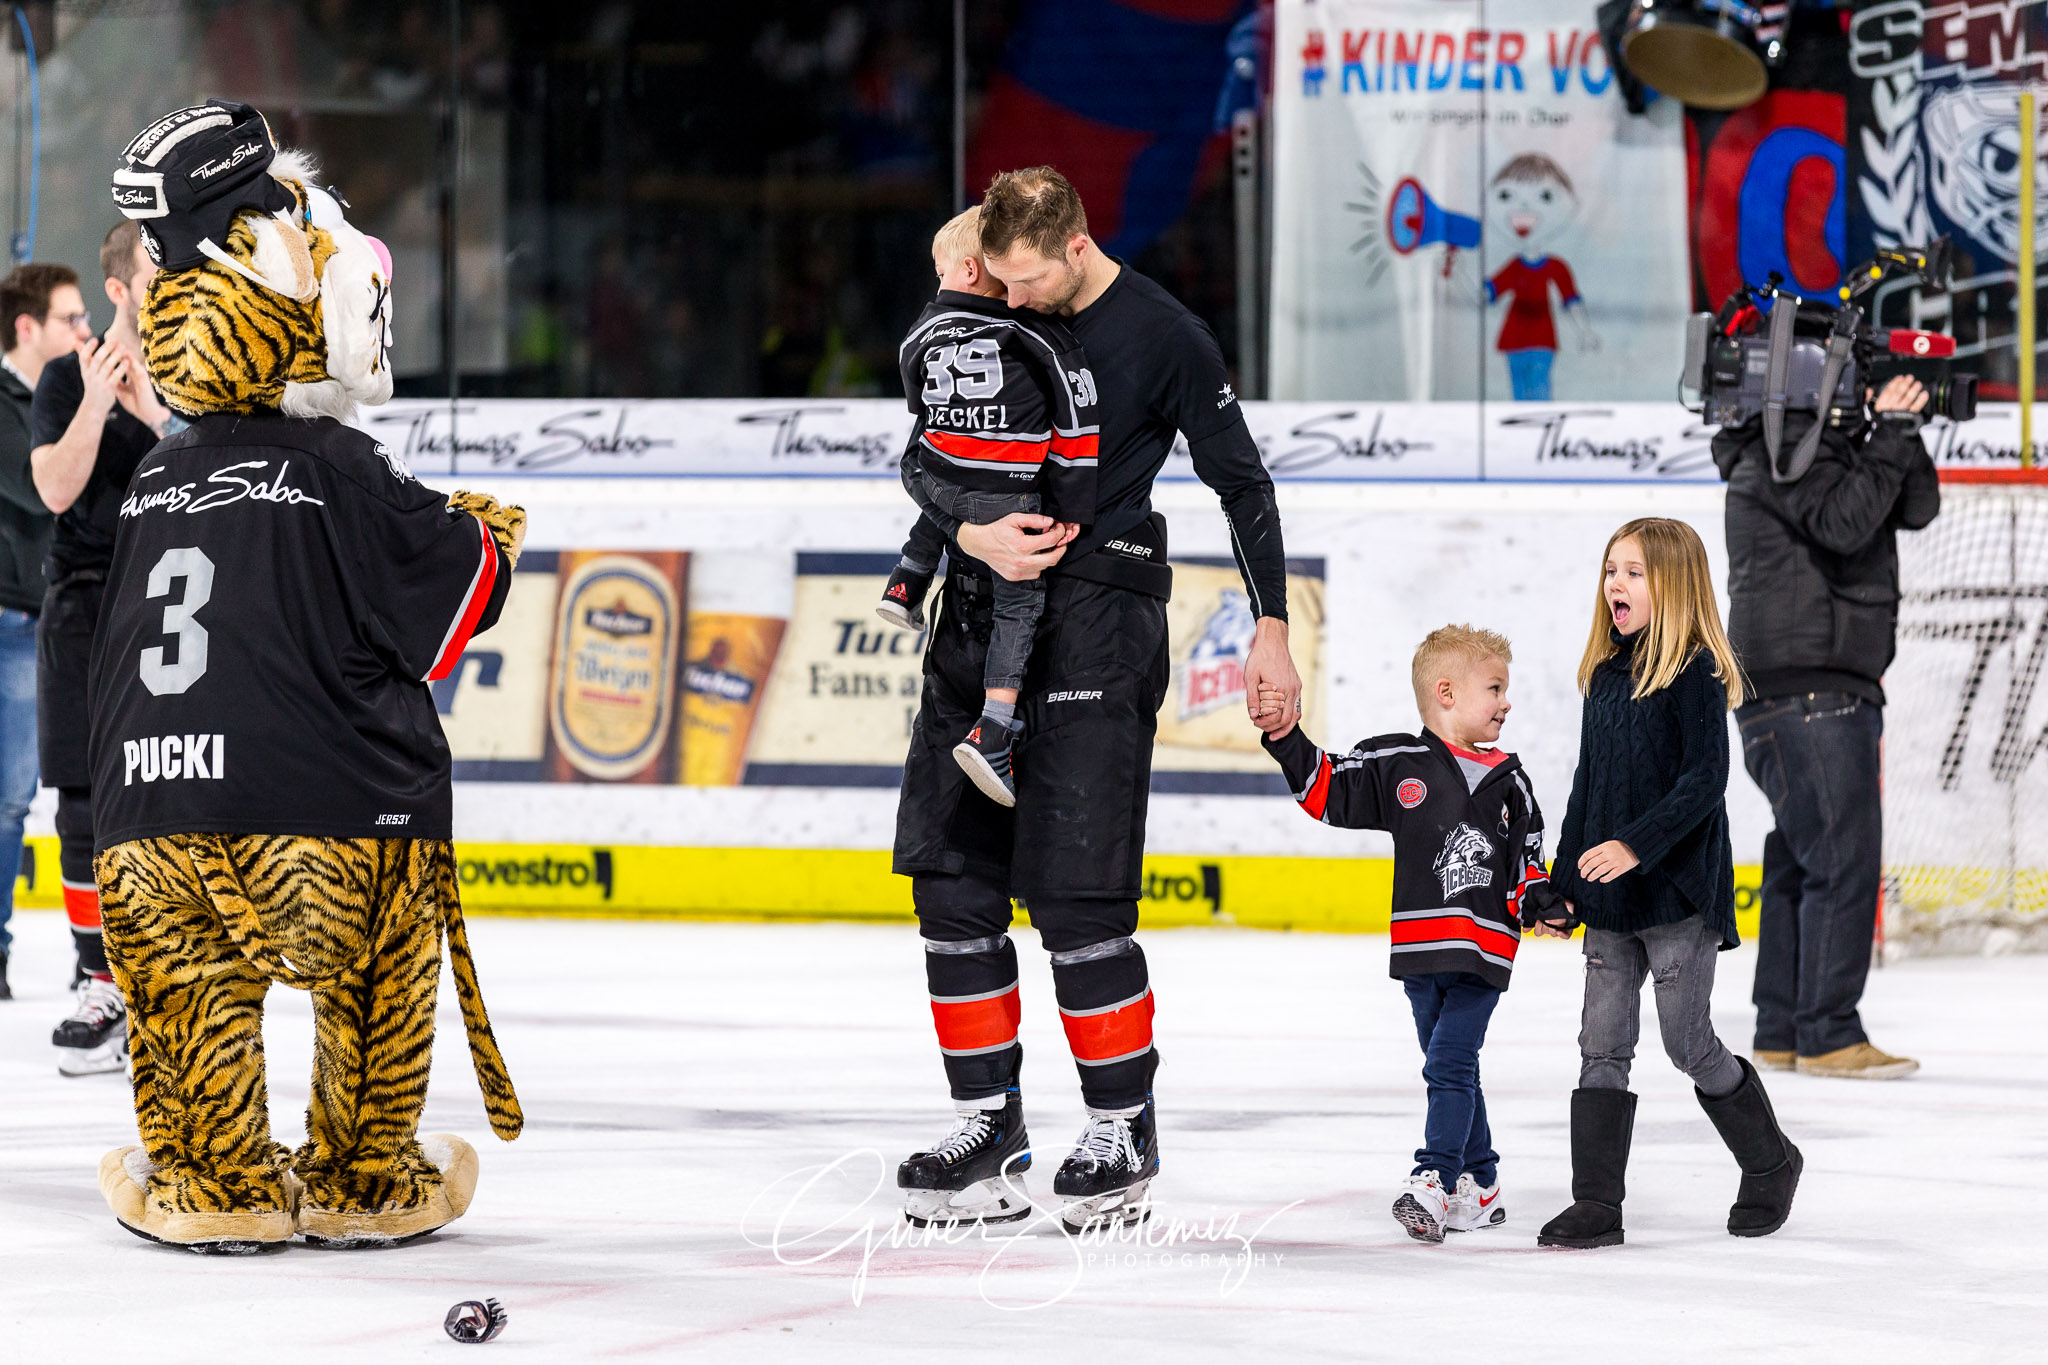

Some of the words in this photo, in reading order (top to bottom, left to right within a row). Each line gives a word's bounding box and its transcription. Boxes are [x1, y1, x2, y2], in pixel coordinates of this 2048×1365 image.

[190, 158, 231, 180] Thomas
[231, 141, 263, 167] Sabo
[122, 189, 154, 205] Sabo
[921, 338, 1004, 406] 39
[371, 405, 523, 467] Thomas
[516, 408, 676, 471] Sabo
[1267, 408, 1436, 473] Sabo
[1500, 408, 1663, 472] Thomas
[185, 459, 325, 514] Sabo
[139, 545, 216, 698] 3
[808, 662, 891, 697] Fans
[123, 734, 225, 787] PUCKI
[457, 855, 592, 888] ovestro
